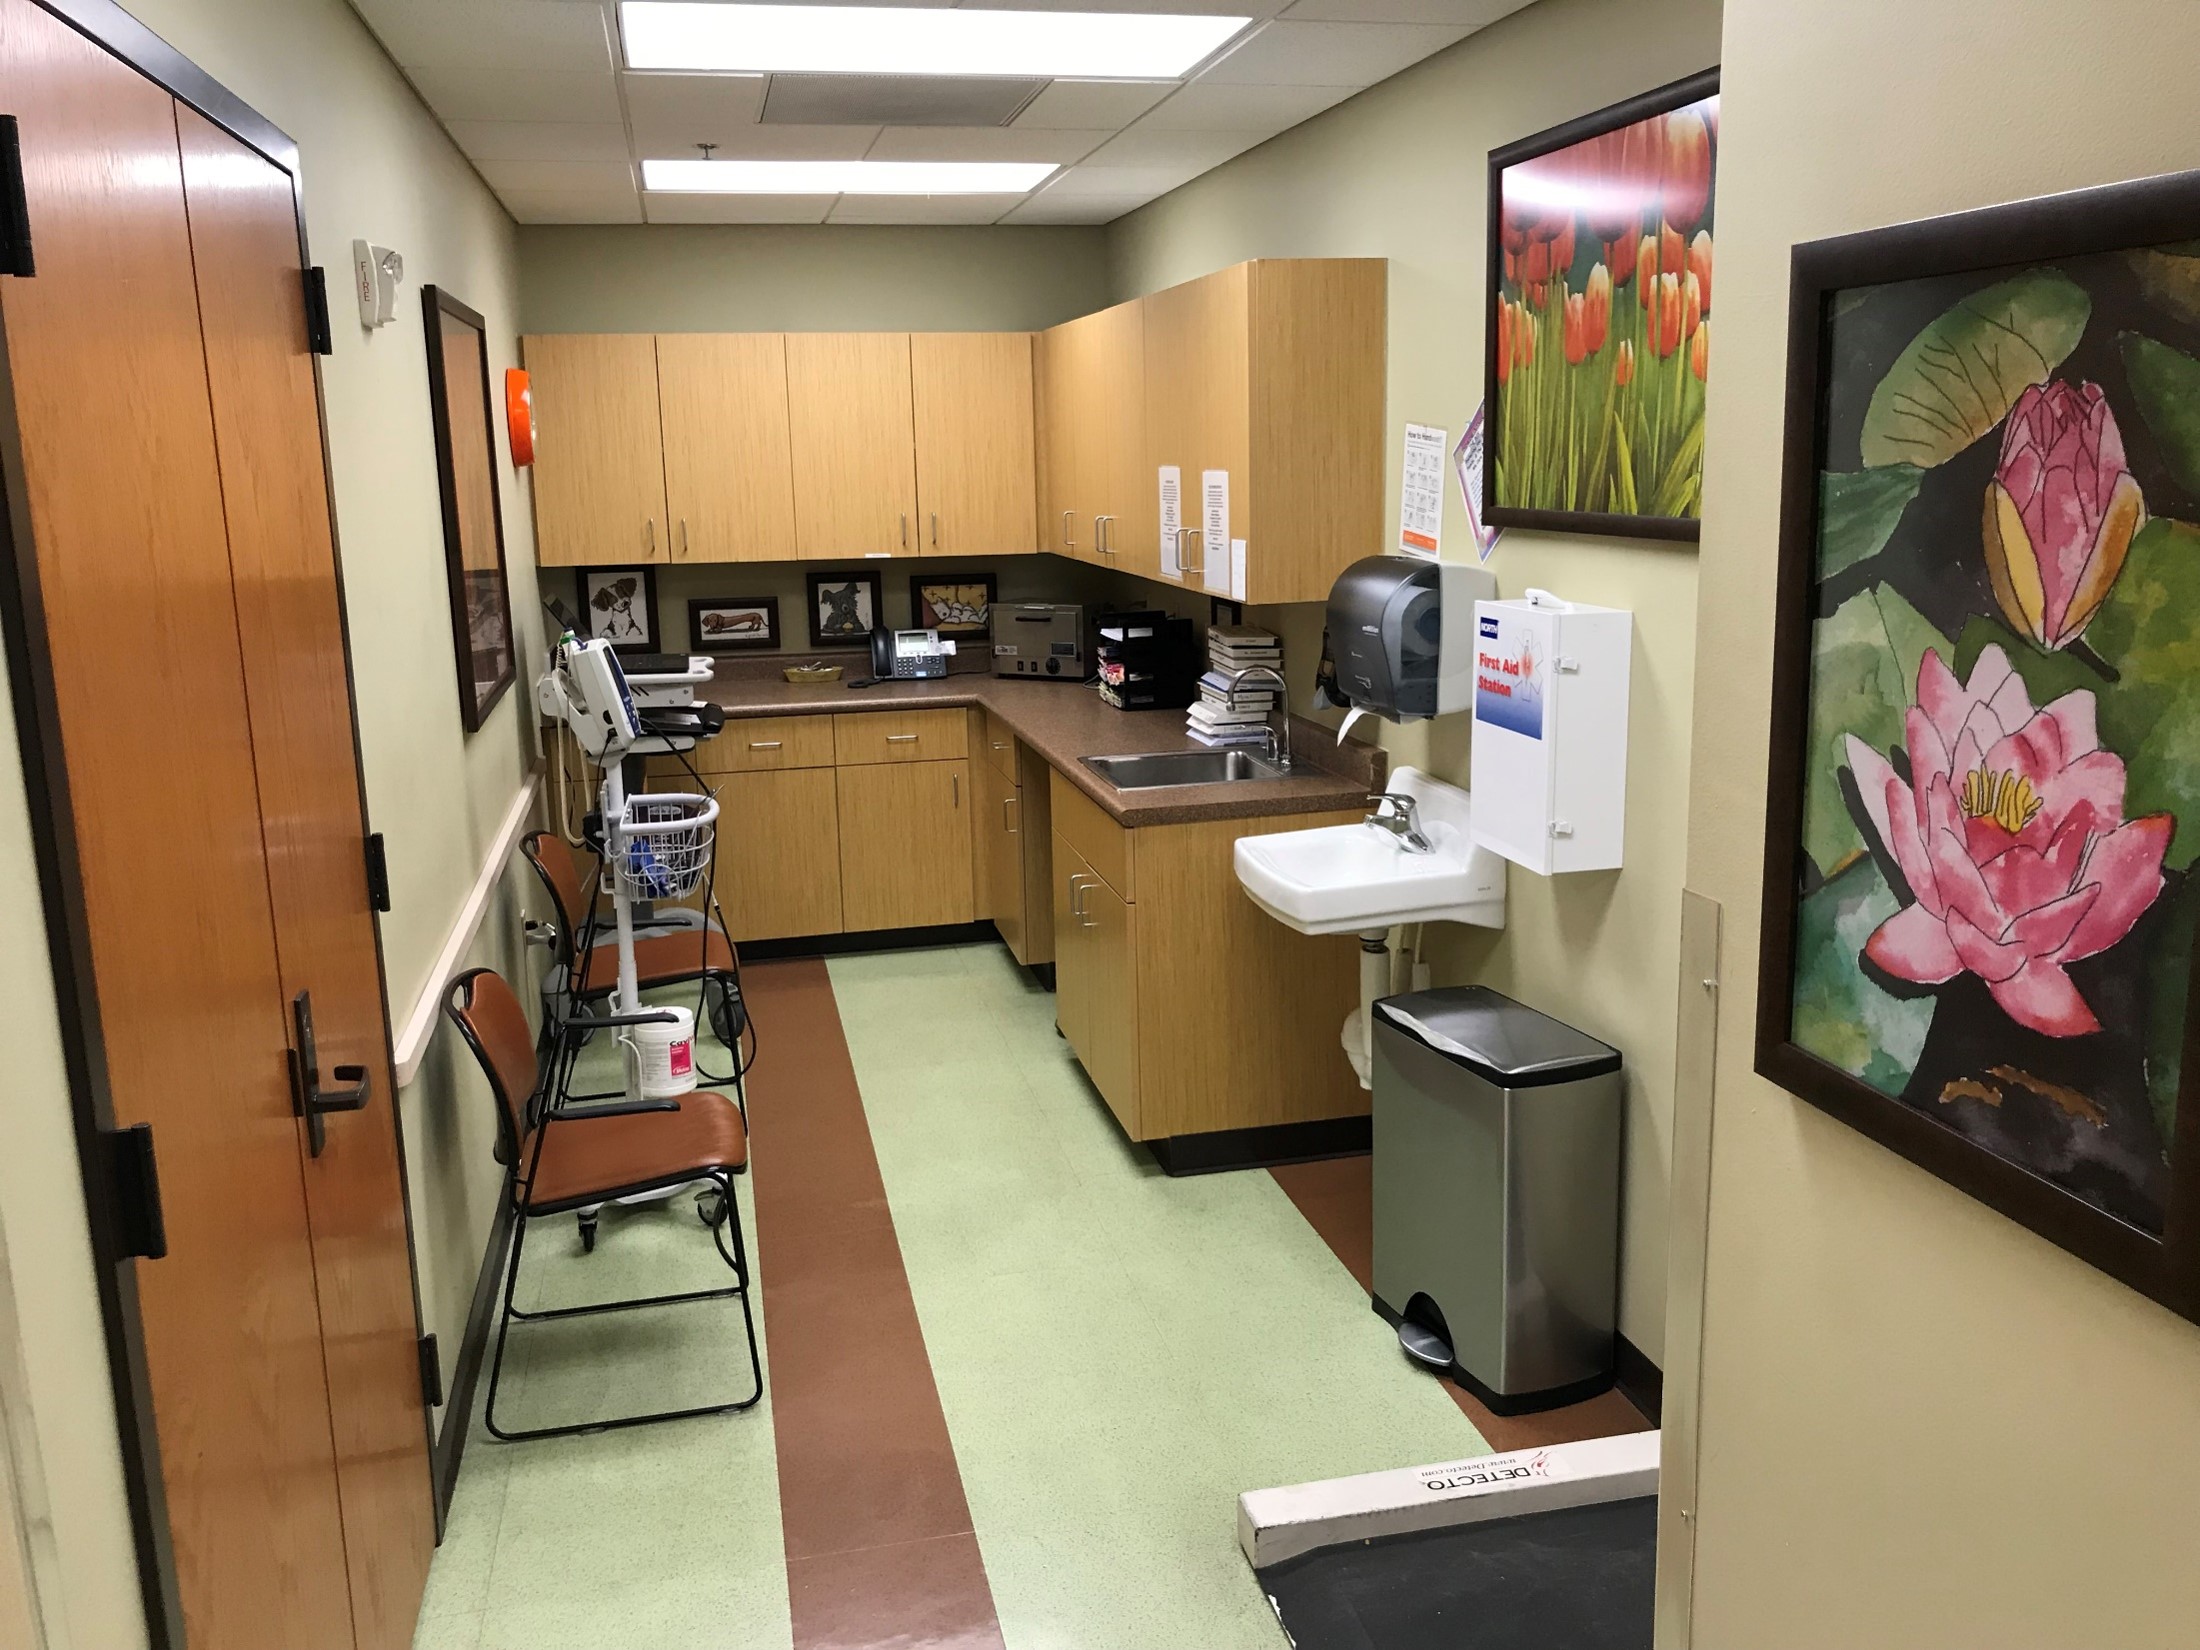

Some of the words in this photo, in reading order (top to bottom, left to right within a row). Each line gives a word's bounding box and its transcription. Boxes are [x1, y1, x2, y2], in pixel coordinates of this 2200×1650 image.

[360, 261, 371, 302] FIRE
[1479, 652, 1500, 671] First
[1502, 658, 1519, 677] Aid
[1478, 675, 1511, 697] Station
[1421, 1459, 1516, 1477] www.Detecto.com
[1427, 1467, 1531, 1490] DETECTO
